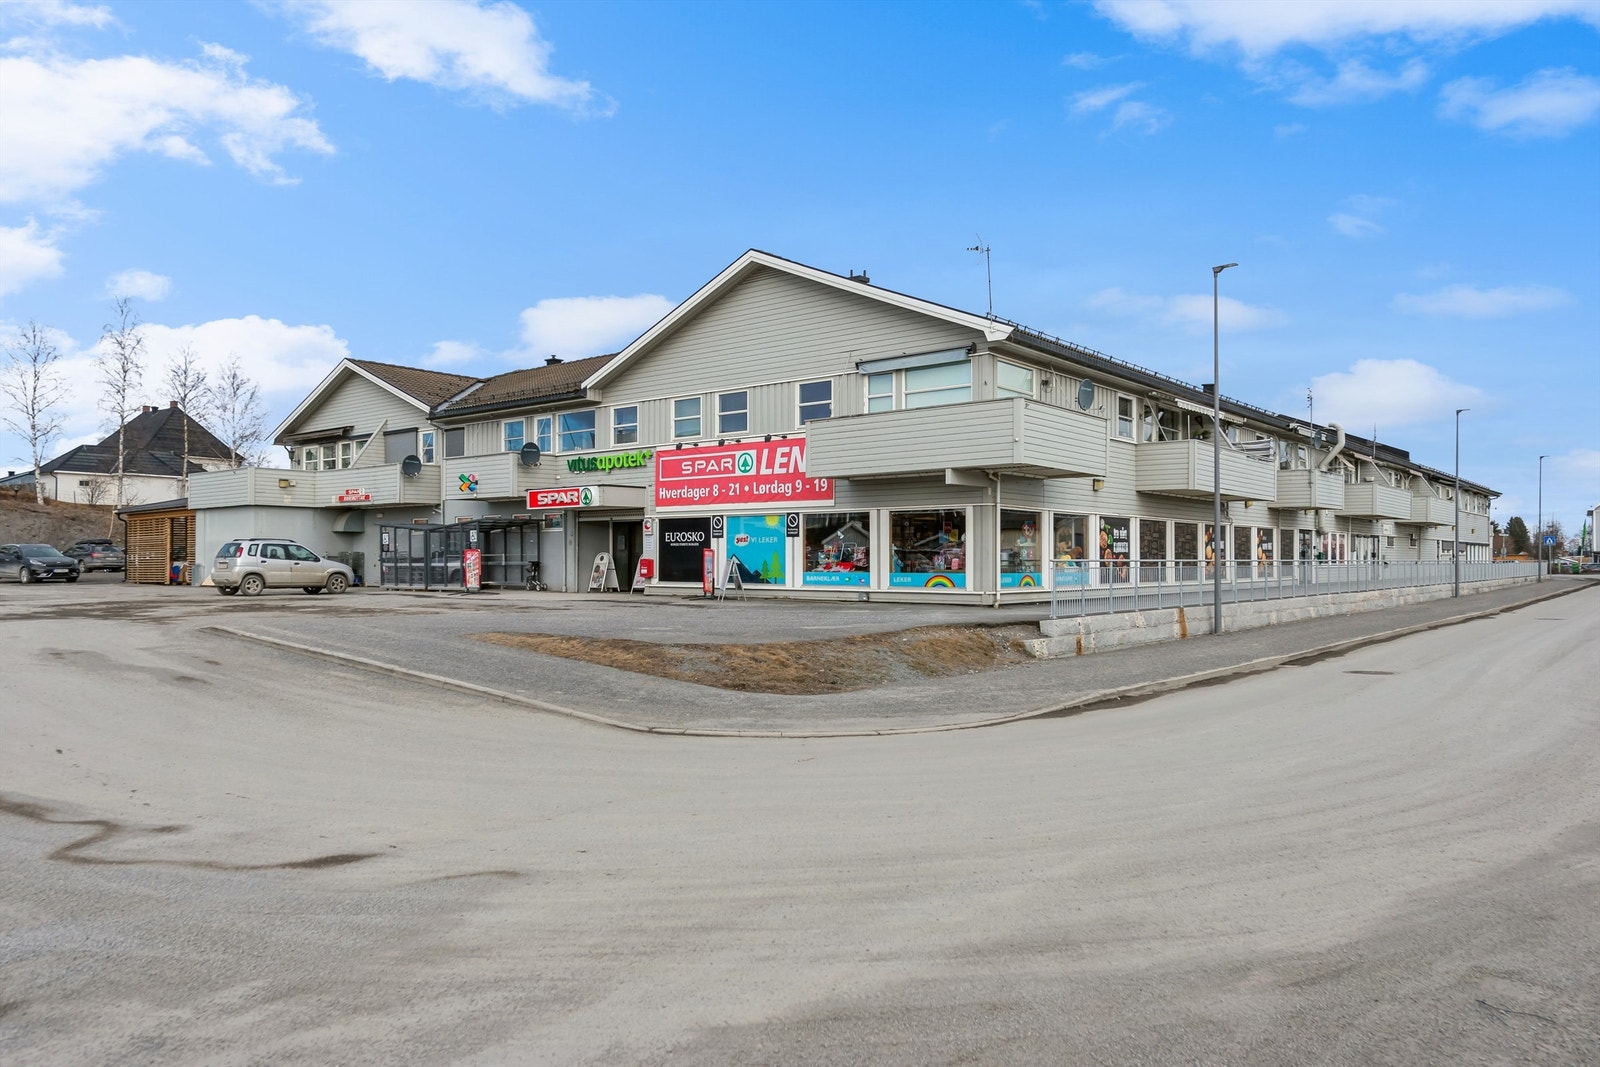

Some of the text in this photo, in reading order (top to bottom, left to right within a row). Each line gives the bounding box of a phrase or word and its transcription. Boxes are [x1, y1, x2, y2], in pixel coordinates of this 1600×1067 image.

[567, 450, 645, 474] vitusapotek
[681, 457, 733, 475] SPAR
[537, 491, 579, 505] SPAR
[659, 485, 710, 501] Hverdager
[712, 484, 719, 497] 8
[728, 482, 740, 496] 21
[753, 480, 792, 497] Lørdag
[795, 479, 803, 493] 9
[813, 478, 828, 492] 19
[665, 531, 705, 542] EUROSKO
